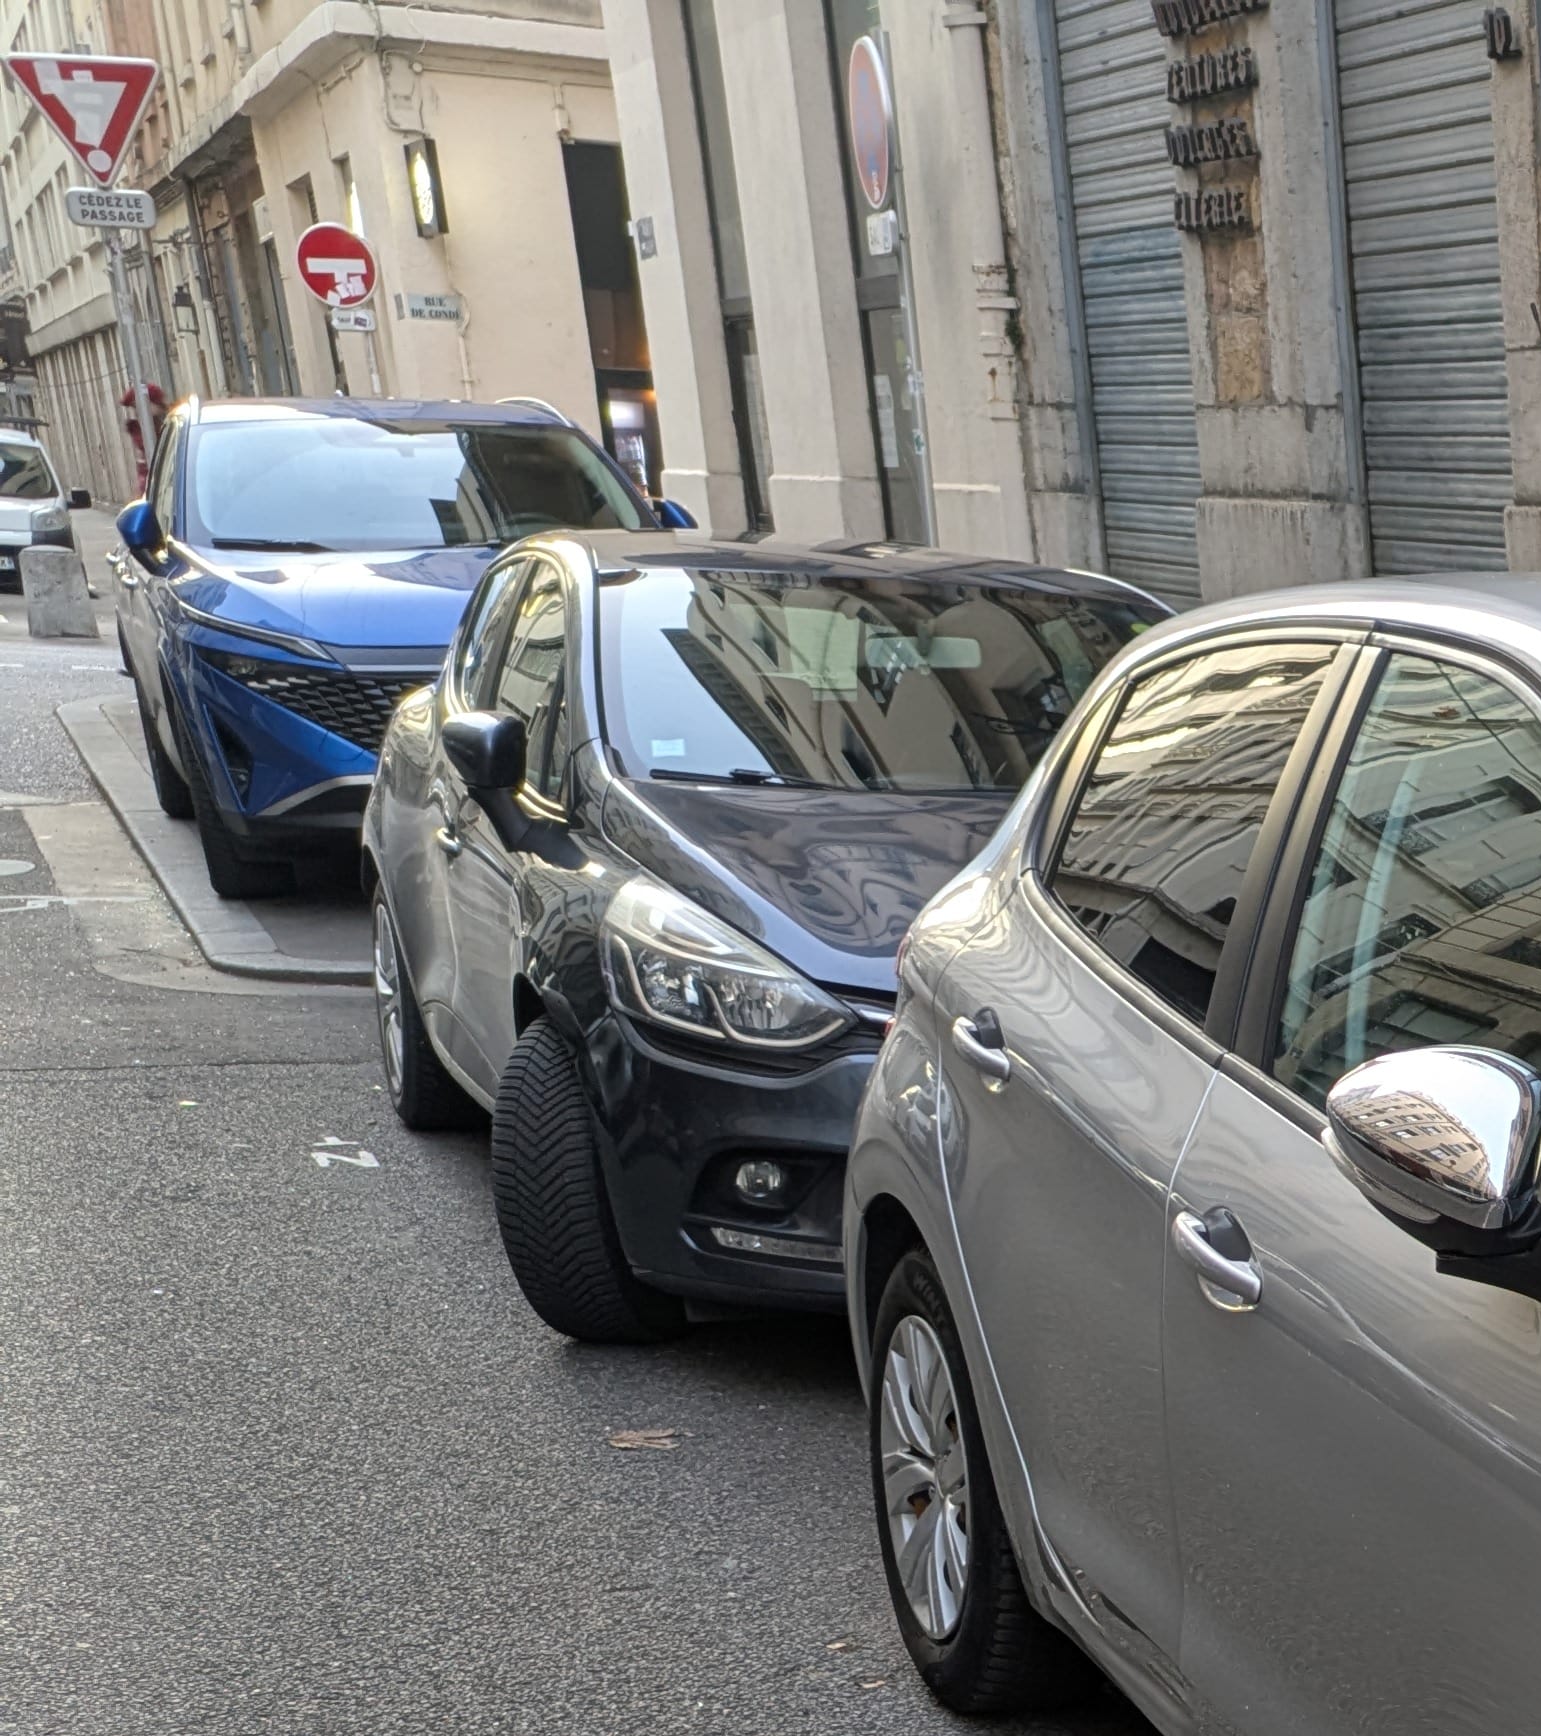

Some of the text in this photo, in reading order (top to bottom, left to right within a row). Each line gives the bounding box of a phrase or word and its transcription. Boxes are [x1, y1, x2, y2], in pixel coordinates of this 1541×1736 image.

[79, 193, 143, 209] CÉDEZ LE
[81, 209, 145, 223] PASSAGE
[424, 296, 446, 307] RUE
[411, 308, 426, 319] DE
